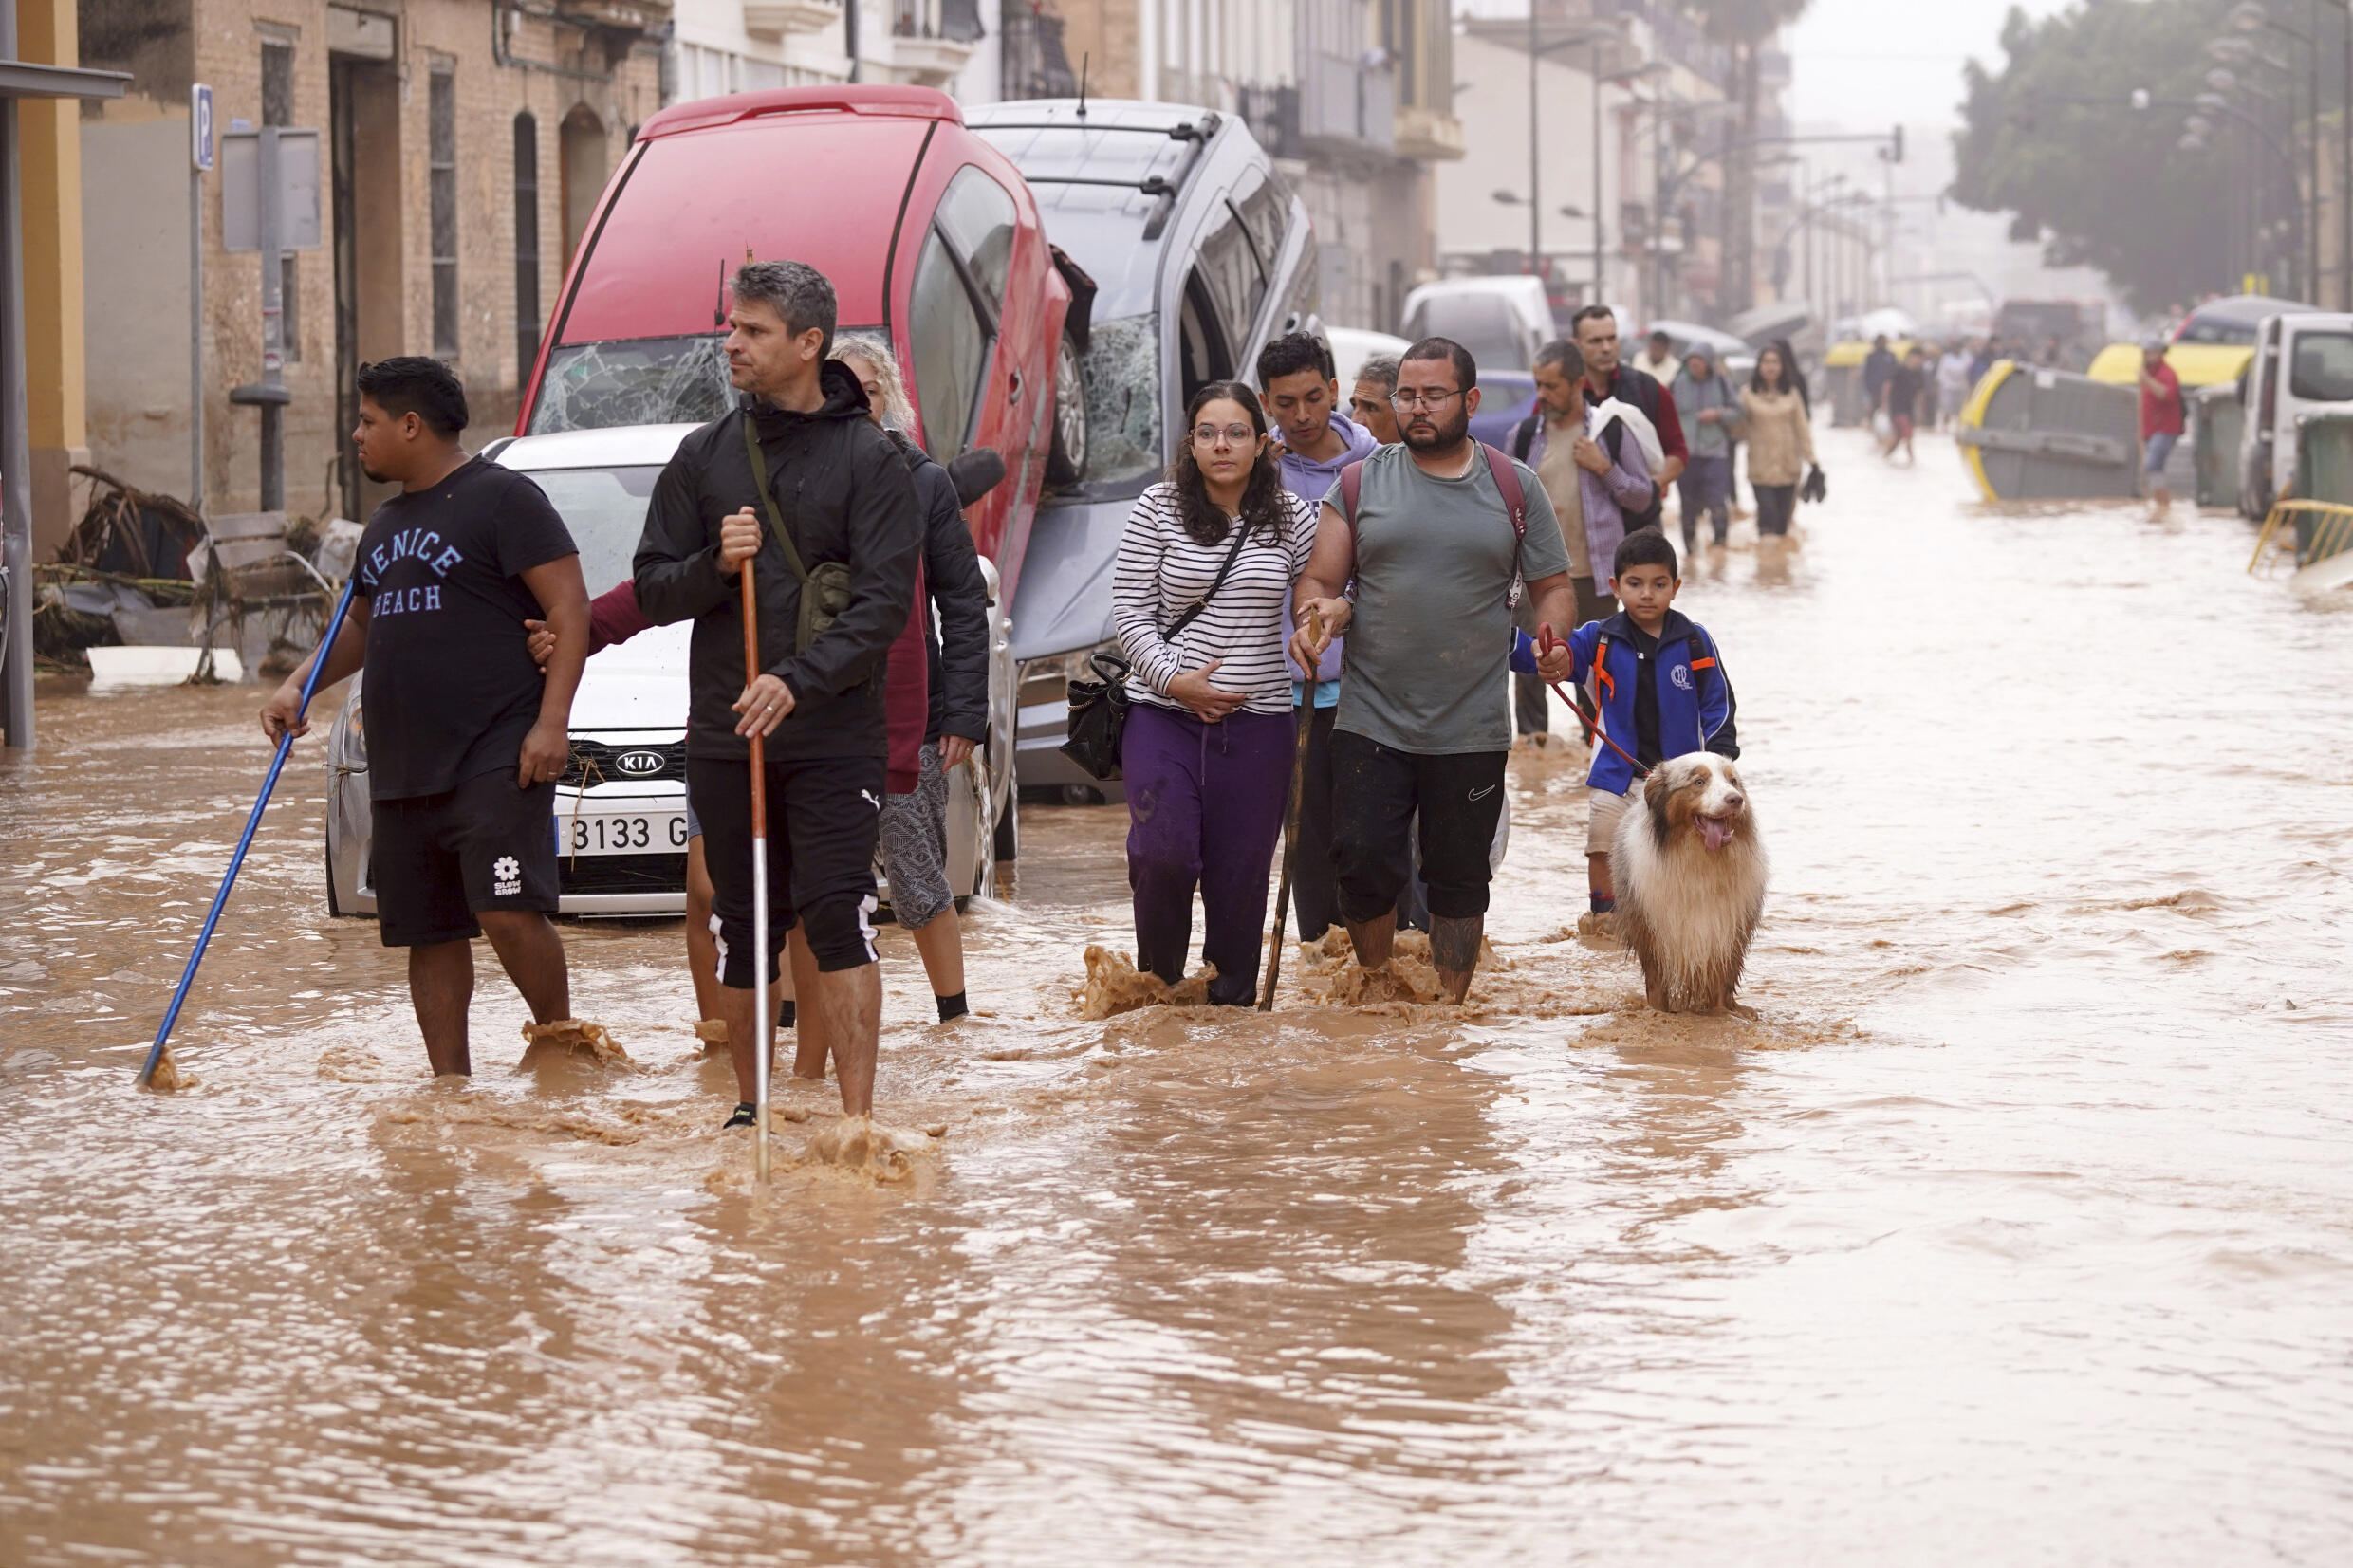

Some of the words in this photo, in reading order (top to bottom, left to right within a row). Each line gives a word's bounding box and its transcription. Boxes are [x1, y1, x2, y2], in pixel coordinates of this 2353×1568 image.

[200, 99, 210, 156] P
[362, 527, 463, 586] VENICE
[373, 585, 441, 618] BEACH
[623, 756, 657, 770] KIA
[571, 818, 650, 850] 3133
[669, 817, 688, 847] G
[494, 880, 522, 890] SLOW
[494, 886, 521, 896] GROW
